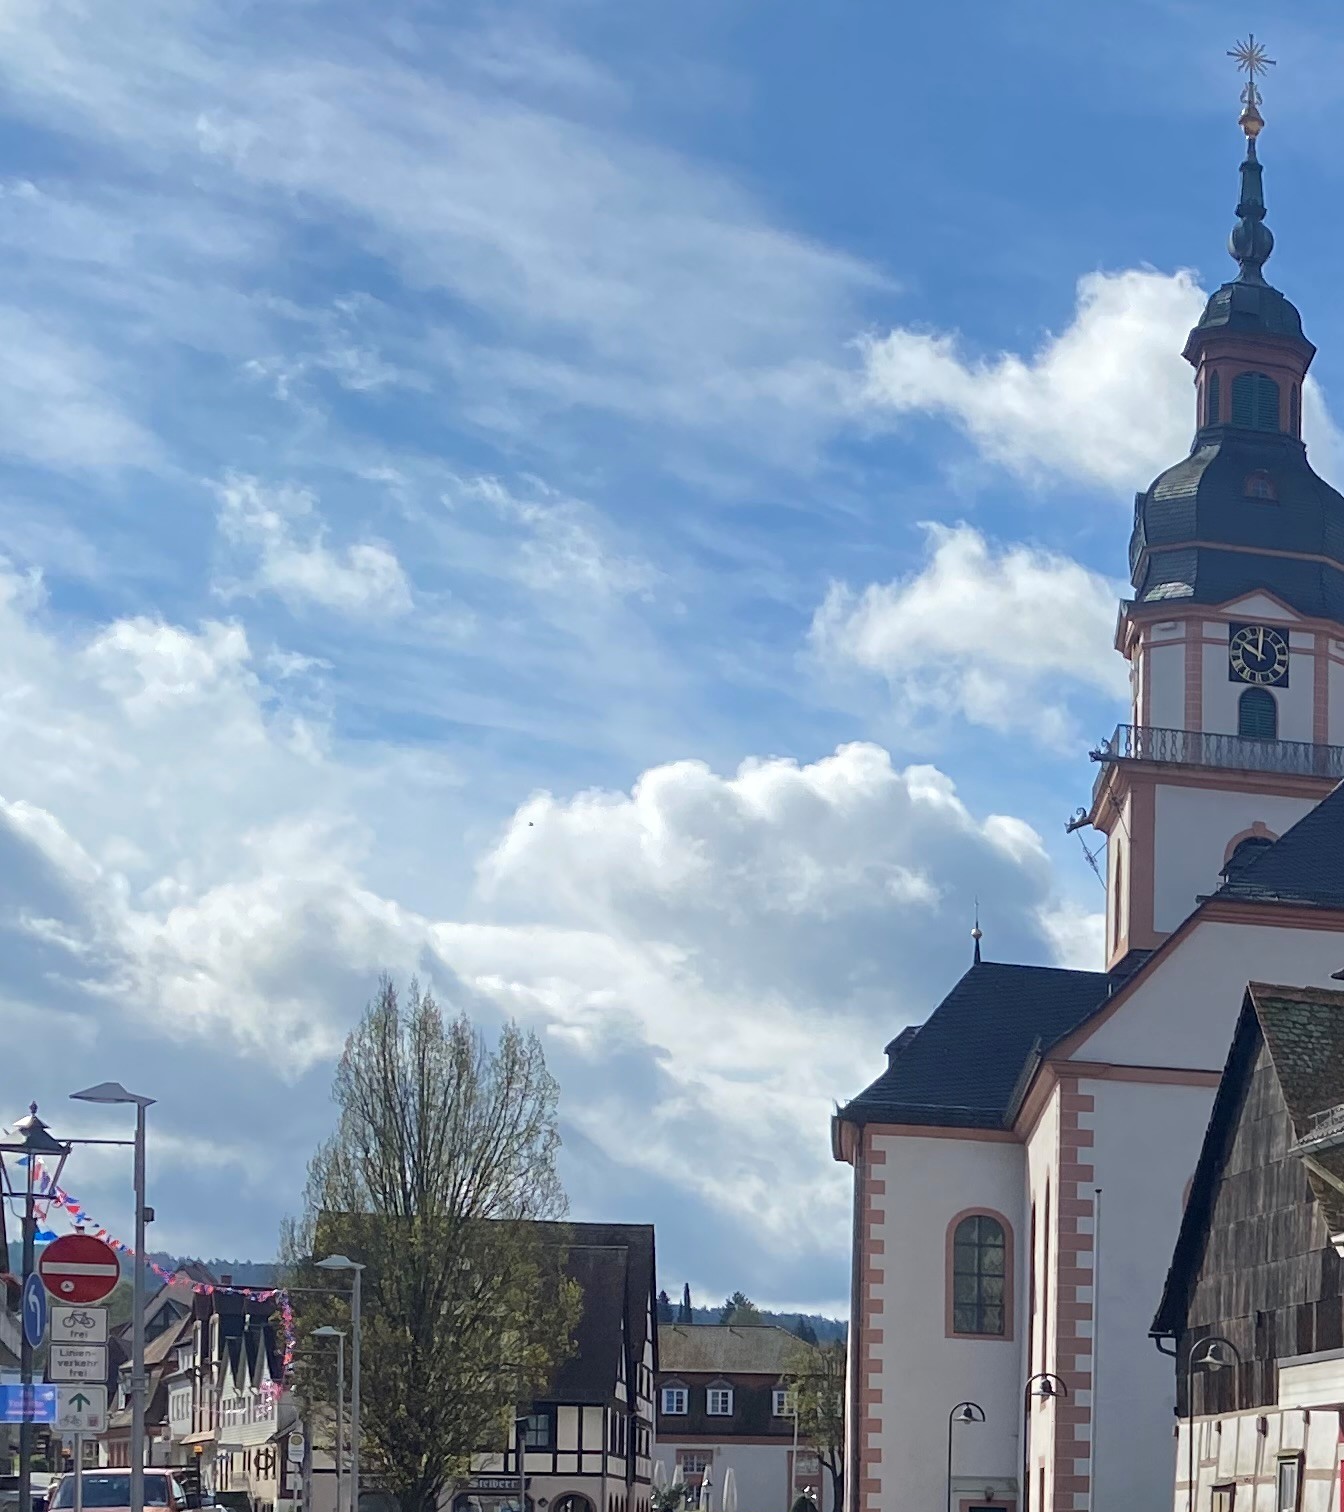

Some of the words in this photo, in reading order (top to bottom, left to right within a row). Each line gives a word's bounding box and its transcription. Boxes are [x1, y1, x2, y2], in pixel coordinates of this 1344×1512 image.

[70, 1330, 88, 1338] frei
[57, 1359, 98, 1367] verkehr
[69, 1369, 88, 1378] frei
